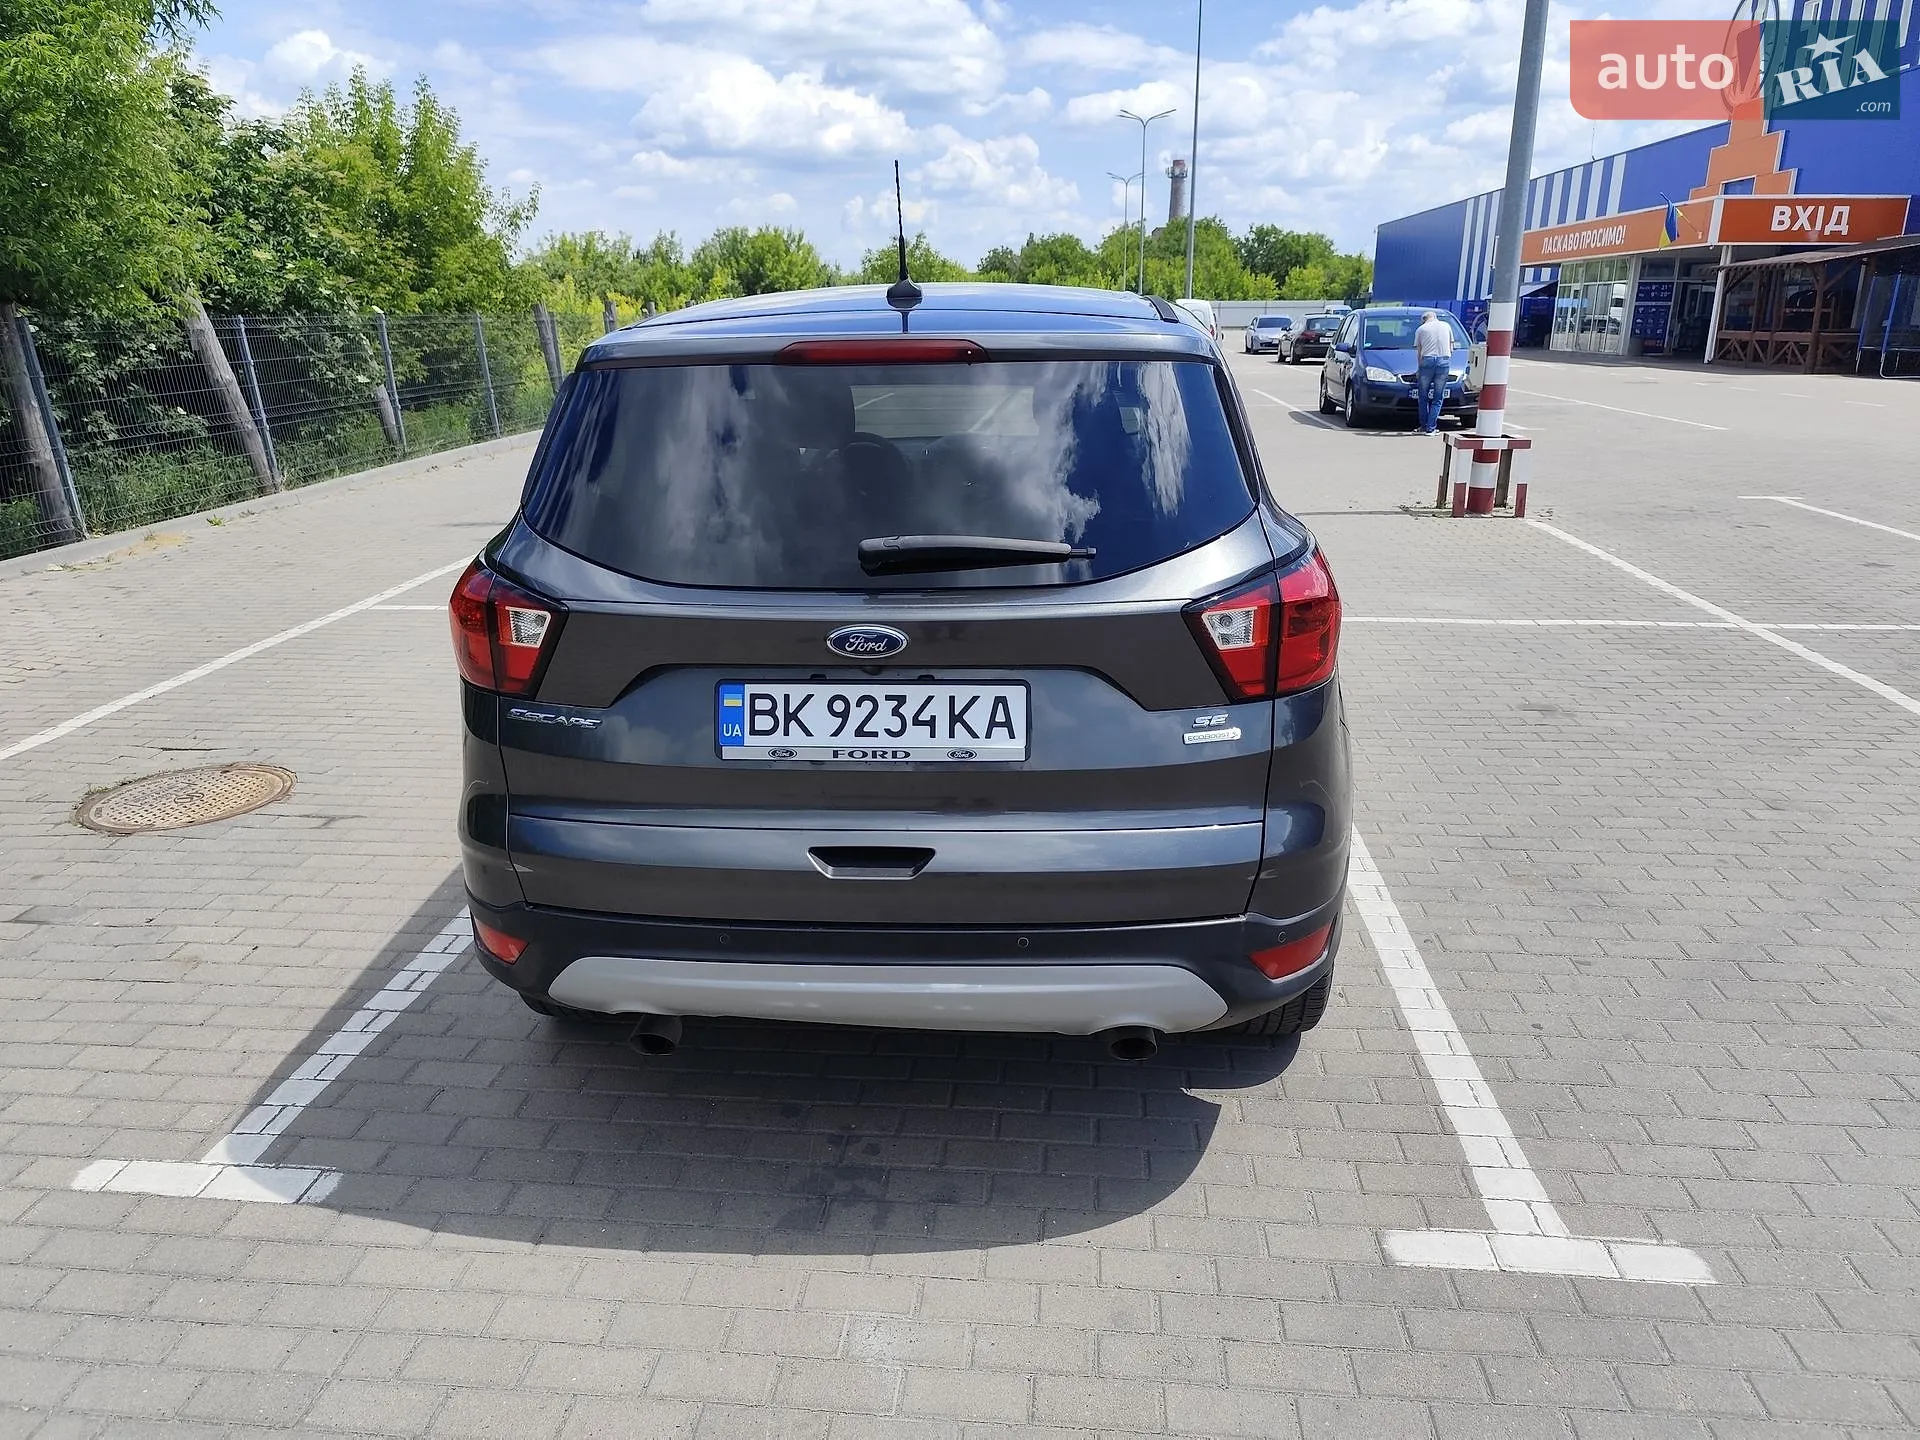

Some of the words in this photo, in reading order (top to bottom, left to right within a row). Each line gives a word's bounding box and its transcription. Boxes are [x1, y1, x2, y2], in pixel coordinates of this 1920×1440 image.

[1771, 205, 1850, 236] ВХІД
[1541, 232, 1580, 254] ЛАСКАВО
[1580, 225, 1626, 249] ПРОСИМО!
[845, 633, 888, 653] Ford
[749, 693, 815, 737] BK
[826, 694, 937, 738] 9234
[948, 695, 1016, 739] KA
[1192, 713, 1229, 729] SE
[723, 723, 742, 737] UA
[832, 749, 911, 759] FORD
